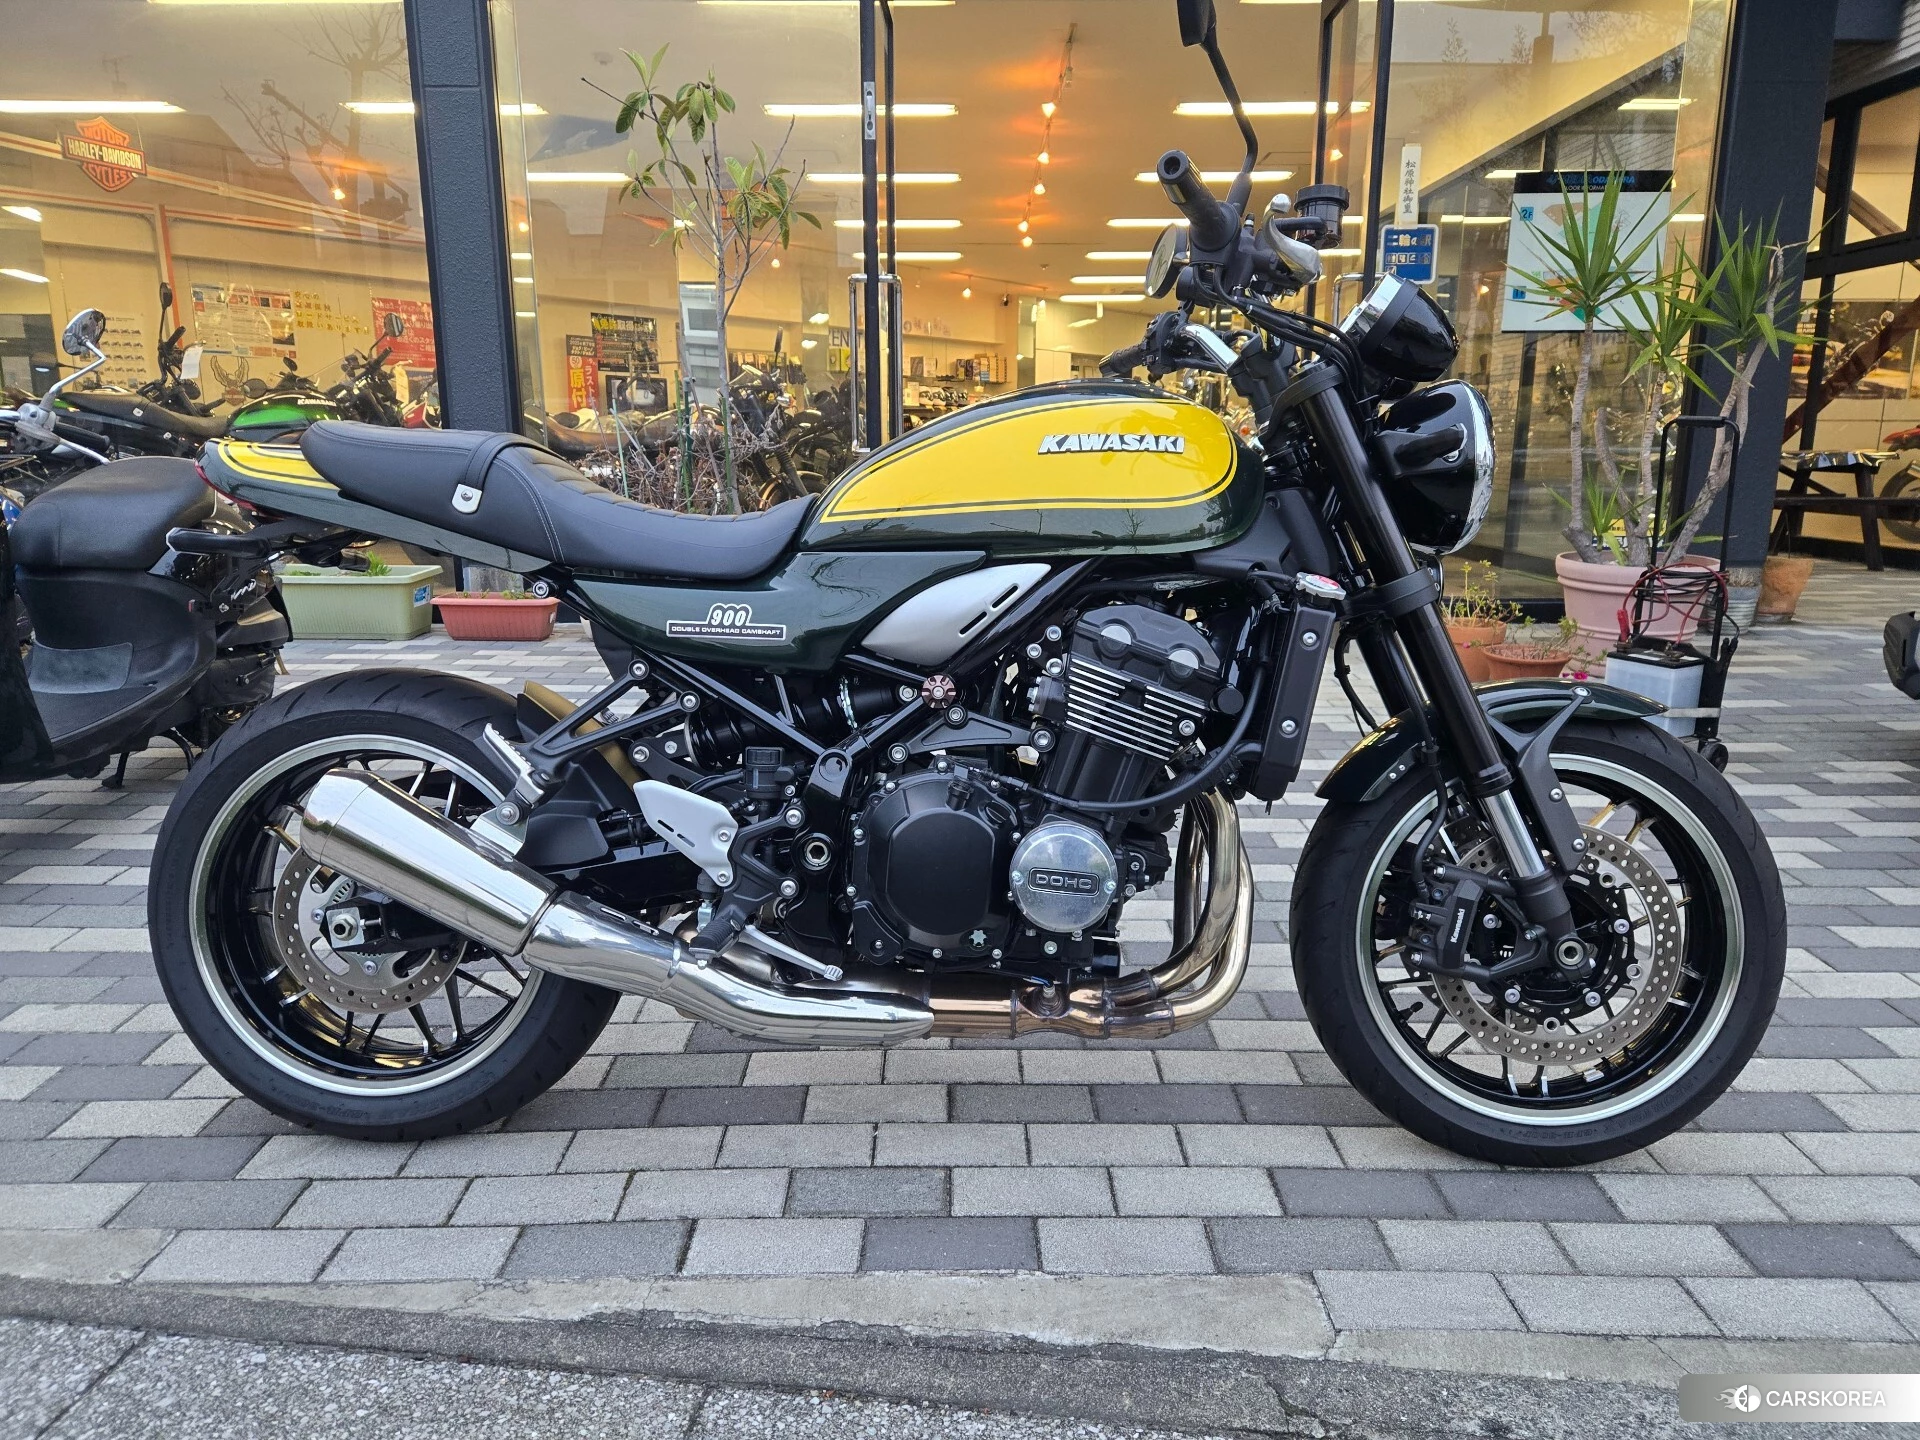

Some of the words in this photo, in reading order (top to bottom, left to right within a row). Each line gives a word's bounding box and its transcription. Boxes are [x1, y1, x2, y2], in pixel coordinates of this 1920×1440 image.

[83, 123, 127, 147] MOTOR
[67, 138, 142, 170] HARLEY-DAVIDSON
[87, 162, 127, 187] CYCLES
[570, 368, 587, 408] 原付
[1038, 433, 1185, 454] KAWASAKI
[710, 609, 747, 627] 900
[671, 625, 700, 633] DOUBLE
[701, 626, 740, 635] OVERHEAD
[741, 627, 781, 636] CAMSHAFT
[1035, 873, 1092, 890] DOHC
[1449, 908, 1466, 943] Kawasaki
